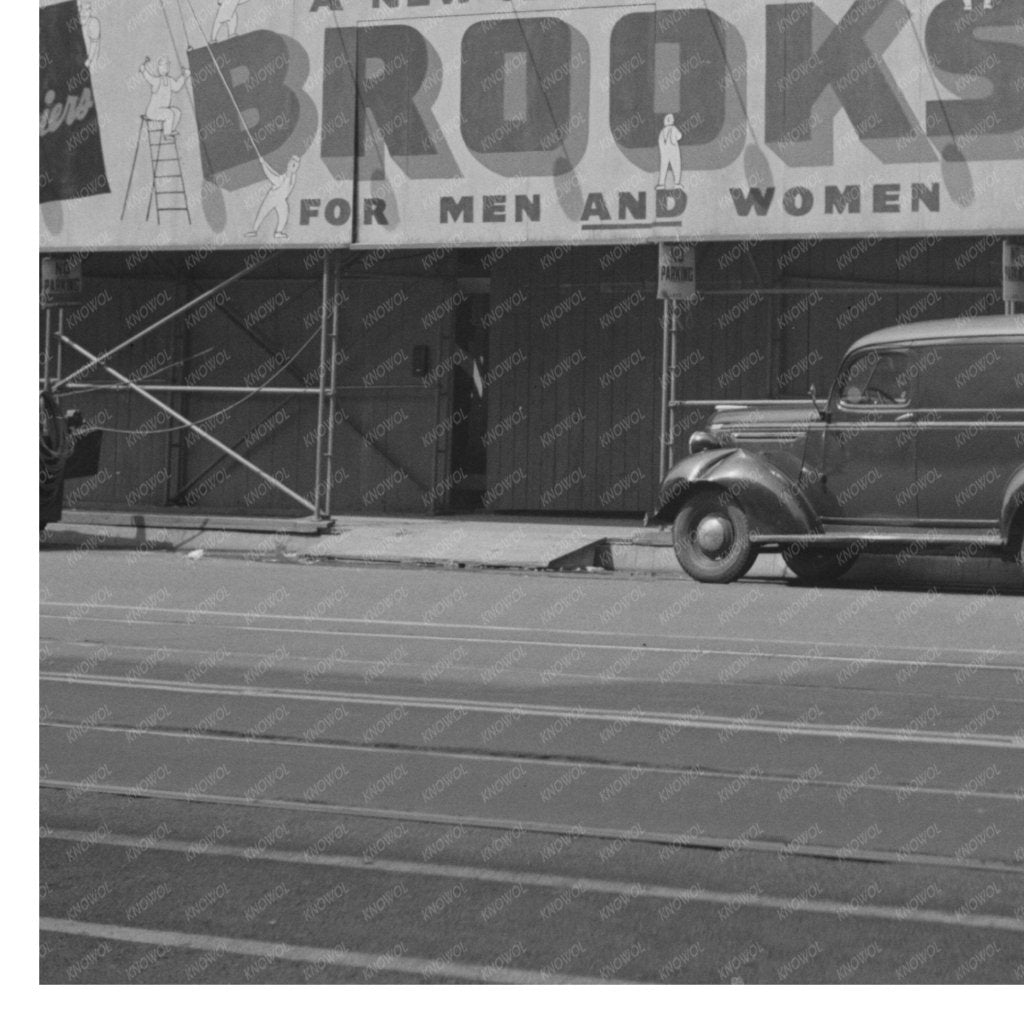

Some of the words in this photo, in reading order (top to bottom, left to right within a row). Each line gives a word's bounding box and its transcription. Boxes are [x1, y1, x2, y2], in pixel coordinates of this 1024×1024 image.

[299, 197, 390, 226] FOR
[439, 194, 541, 224] MEN
[580, 188, 689, 221] AND
[729, 182, 941, 217] WOMEN
